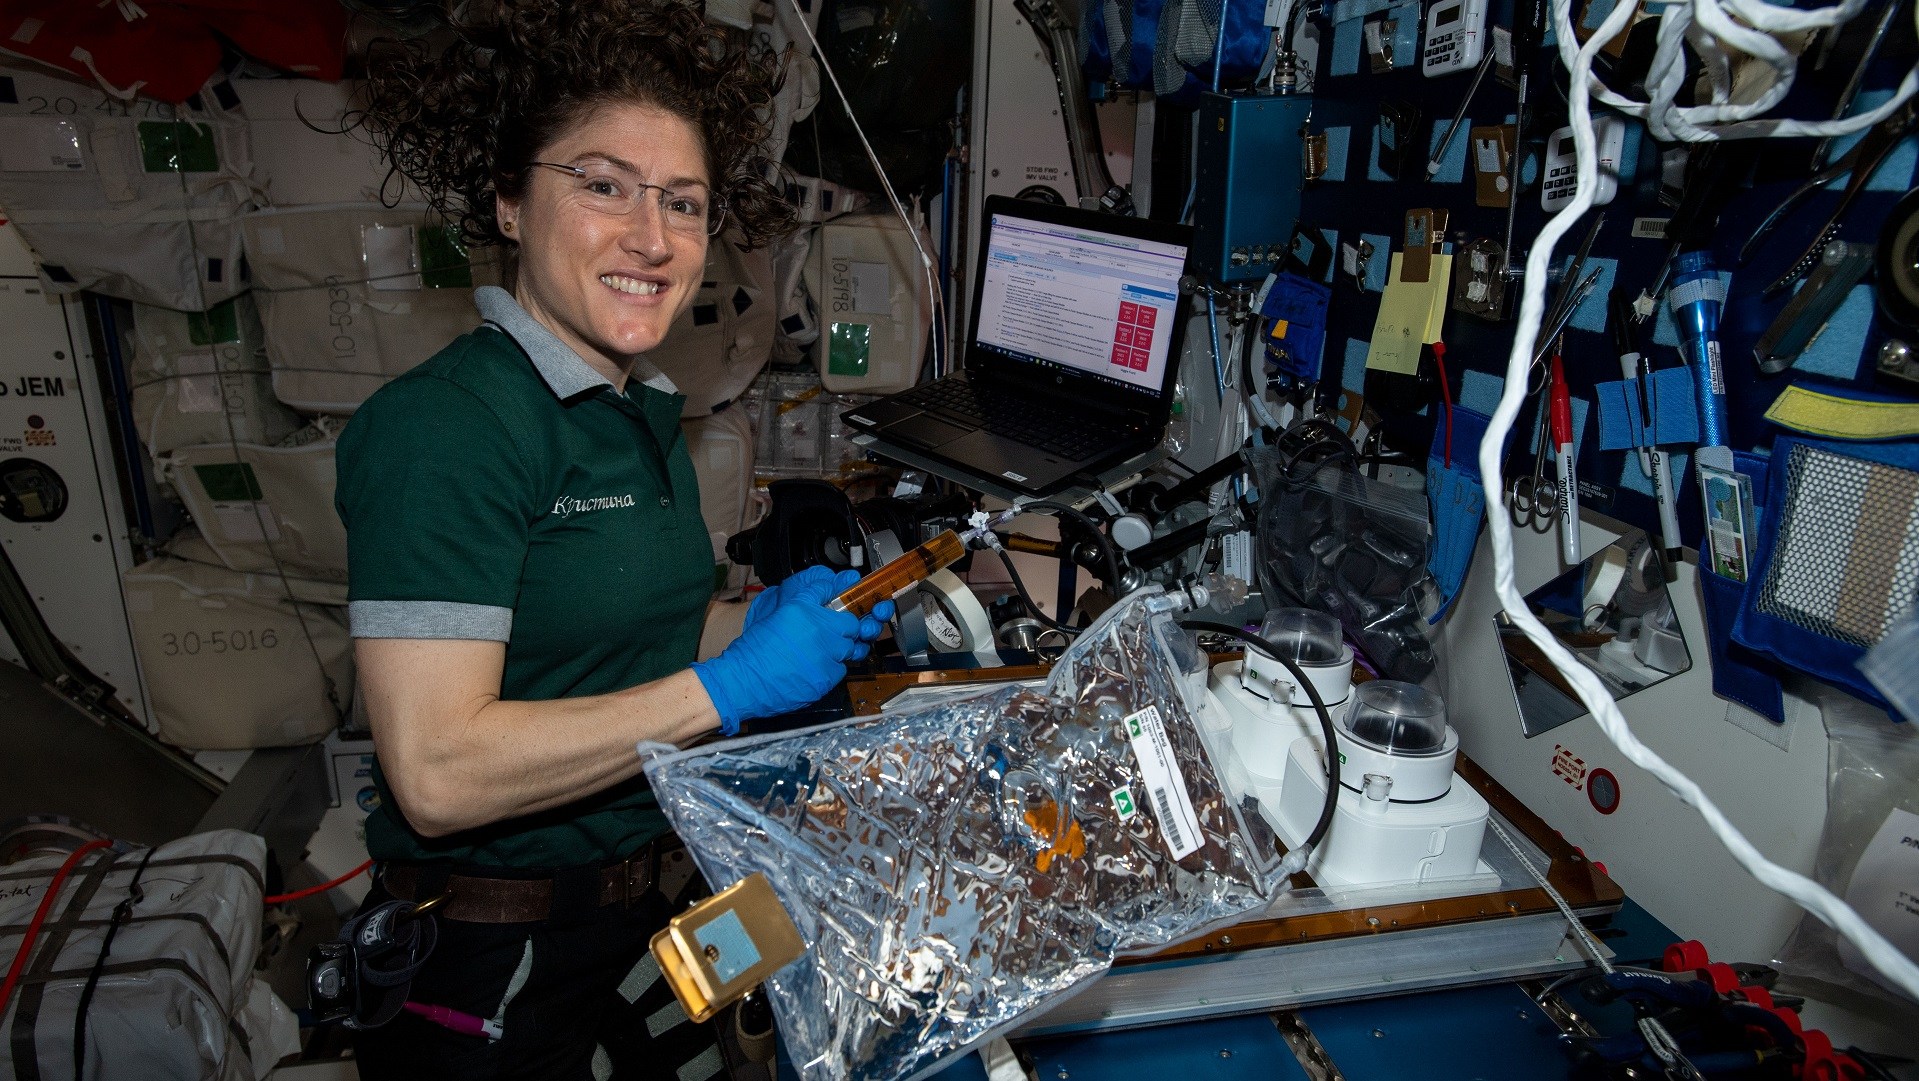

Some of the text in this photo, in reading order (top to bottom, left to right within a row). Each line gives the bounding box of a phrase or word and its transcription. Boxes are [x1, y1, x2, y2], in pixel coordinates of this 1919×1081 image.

[16, 377, 64, 396] JEM
[551, 494, 636, 518] Кристина
[1558, 477, 1570, 524] Sharpie
[1150, 708, 1168, 748] Water Bag
